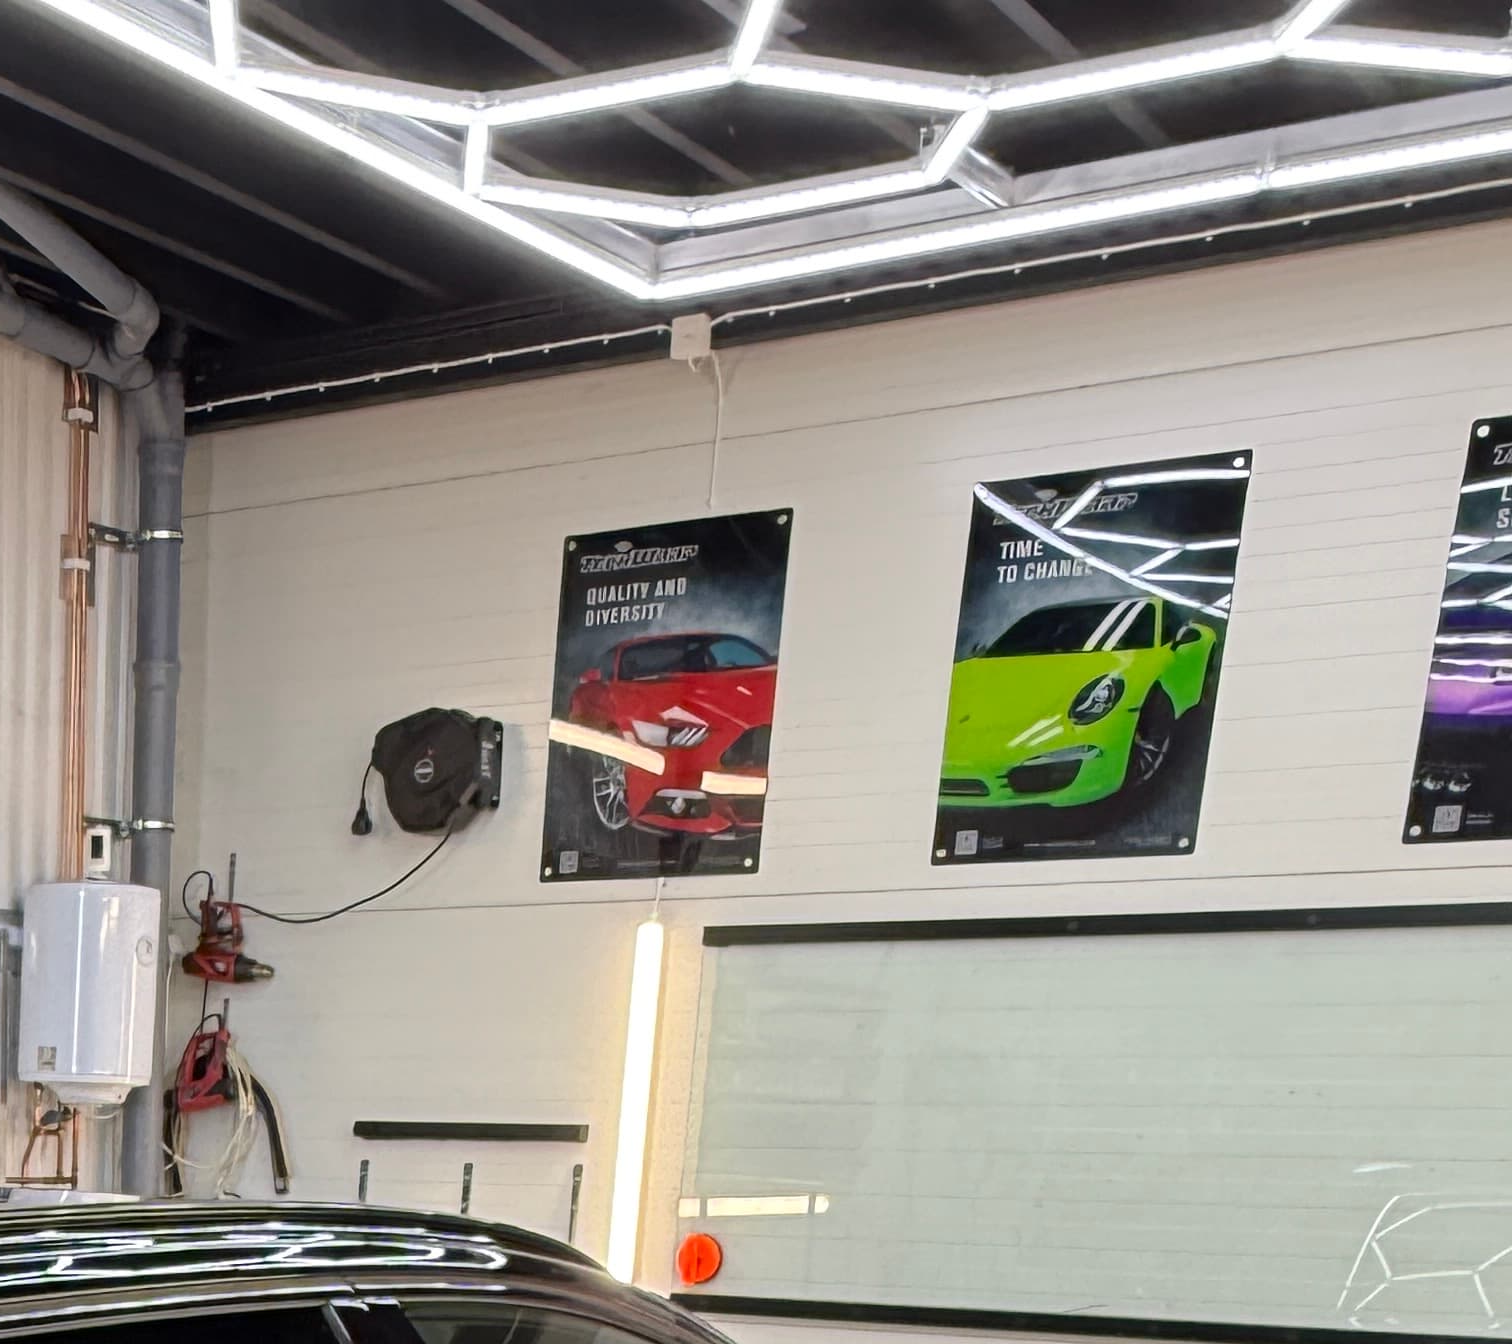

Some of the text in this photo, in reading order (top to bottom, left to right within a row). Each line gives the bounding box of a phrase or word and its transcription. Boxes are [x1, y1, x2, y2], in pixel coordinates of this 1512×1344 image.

[1000, 538, 1044, 560] TIME
[997, 564, 1018, 584] TO
[586, 577, 687, 606] QUALITY AND
[585, 602, 666, 627] DIVERSITY
